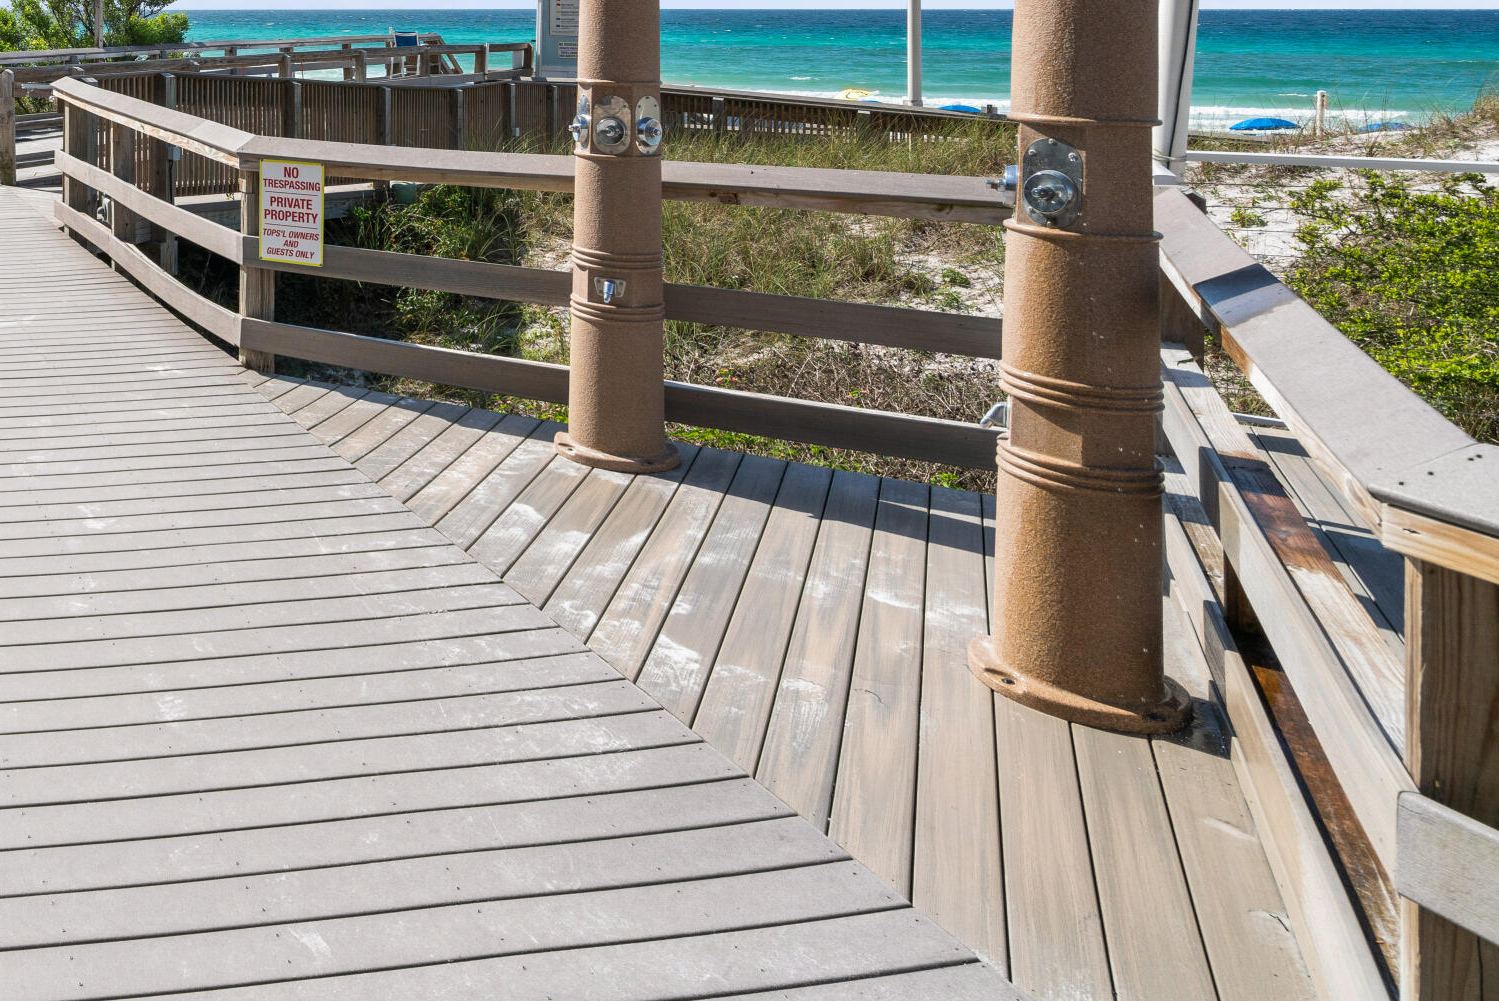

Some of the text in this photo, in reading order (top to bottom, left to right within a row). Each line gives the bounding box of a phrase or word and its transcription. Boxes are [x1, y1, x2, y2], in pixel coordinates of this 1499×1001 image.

[284, 166, 299, 178] NO
[263, 178, 320, 192] TRESPASSING
[270, 196, 312, 210] PRIVATE
[264, 209, 318, 224] PROPERTY
[288, 231, 320, 240] OWNERS
[284, 240, 298, 248] AND
[266, 248, 315, 259] GUESTS ONLY
